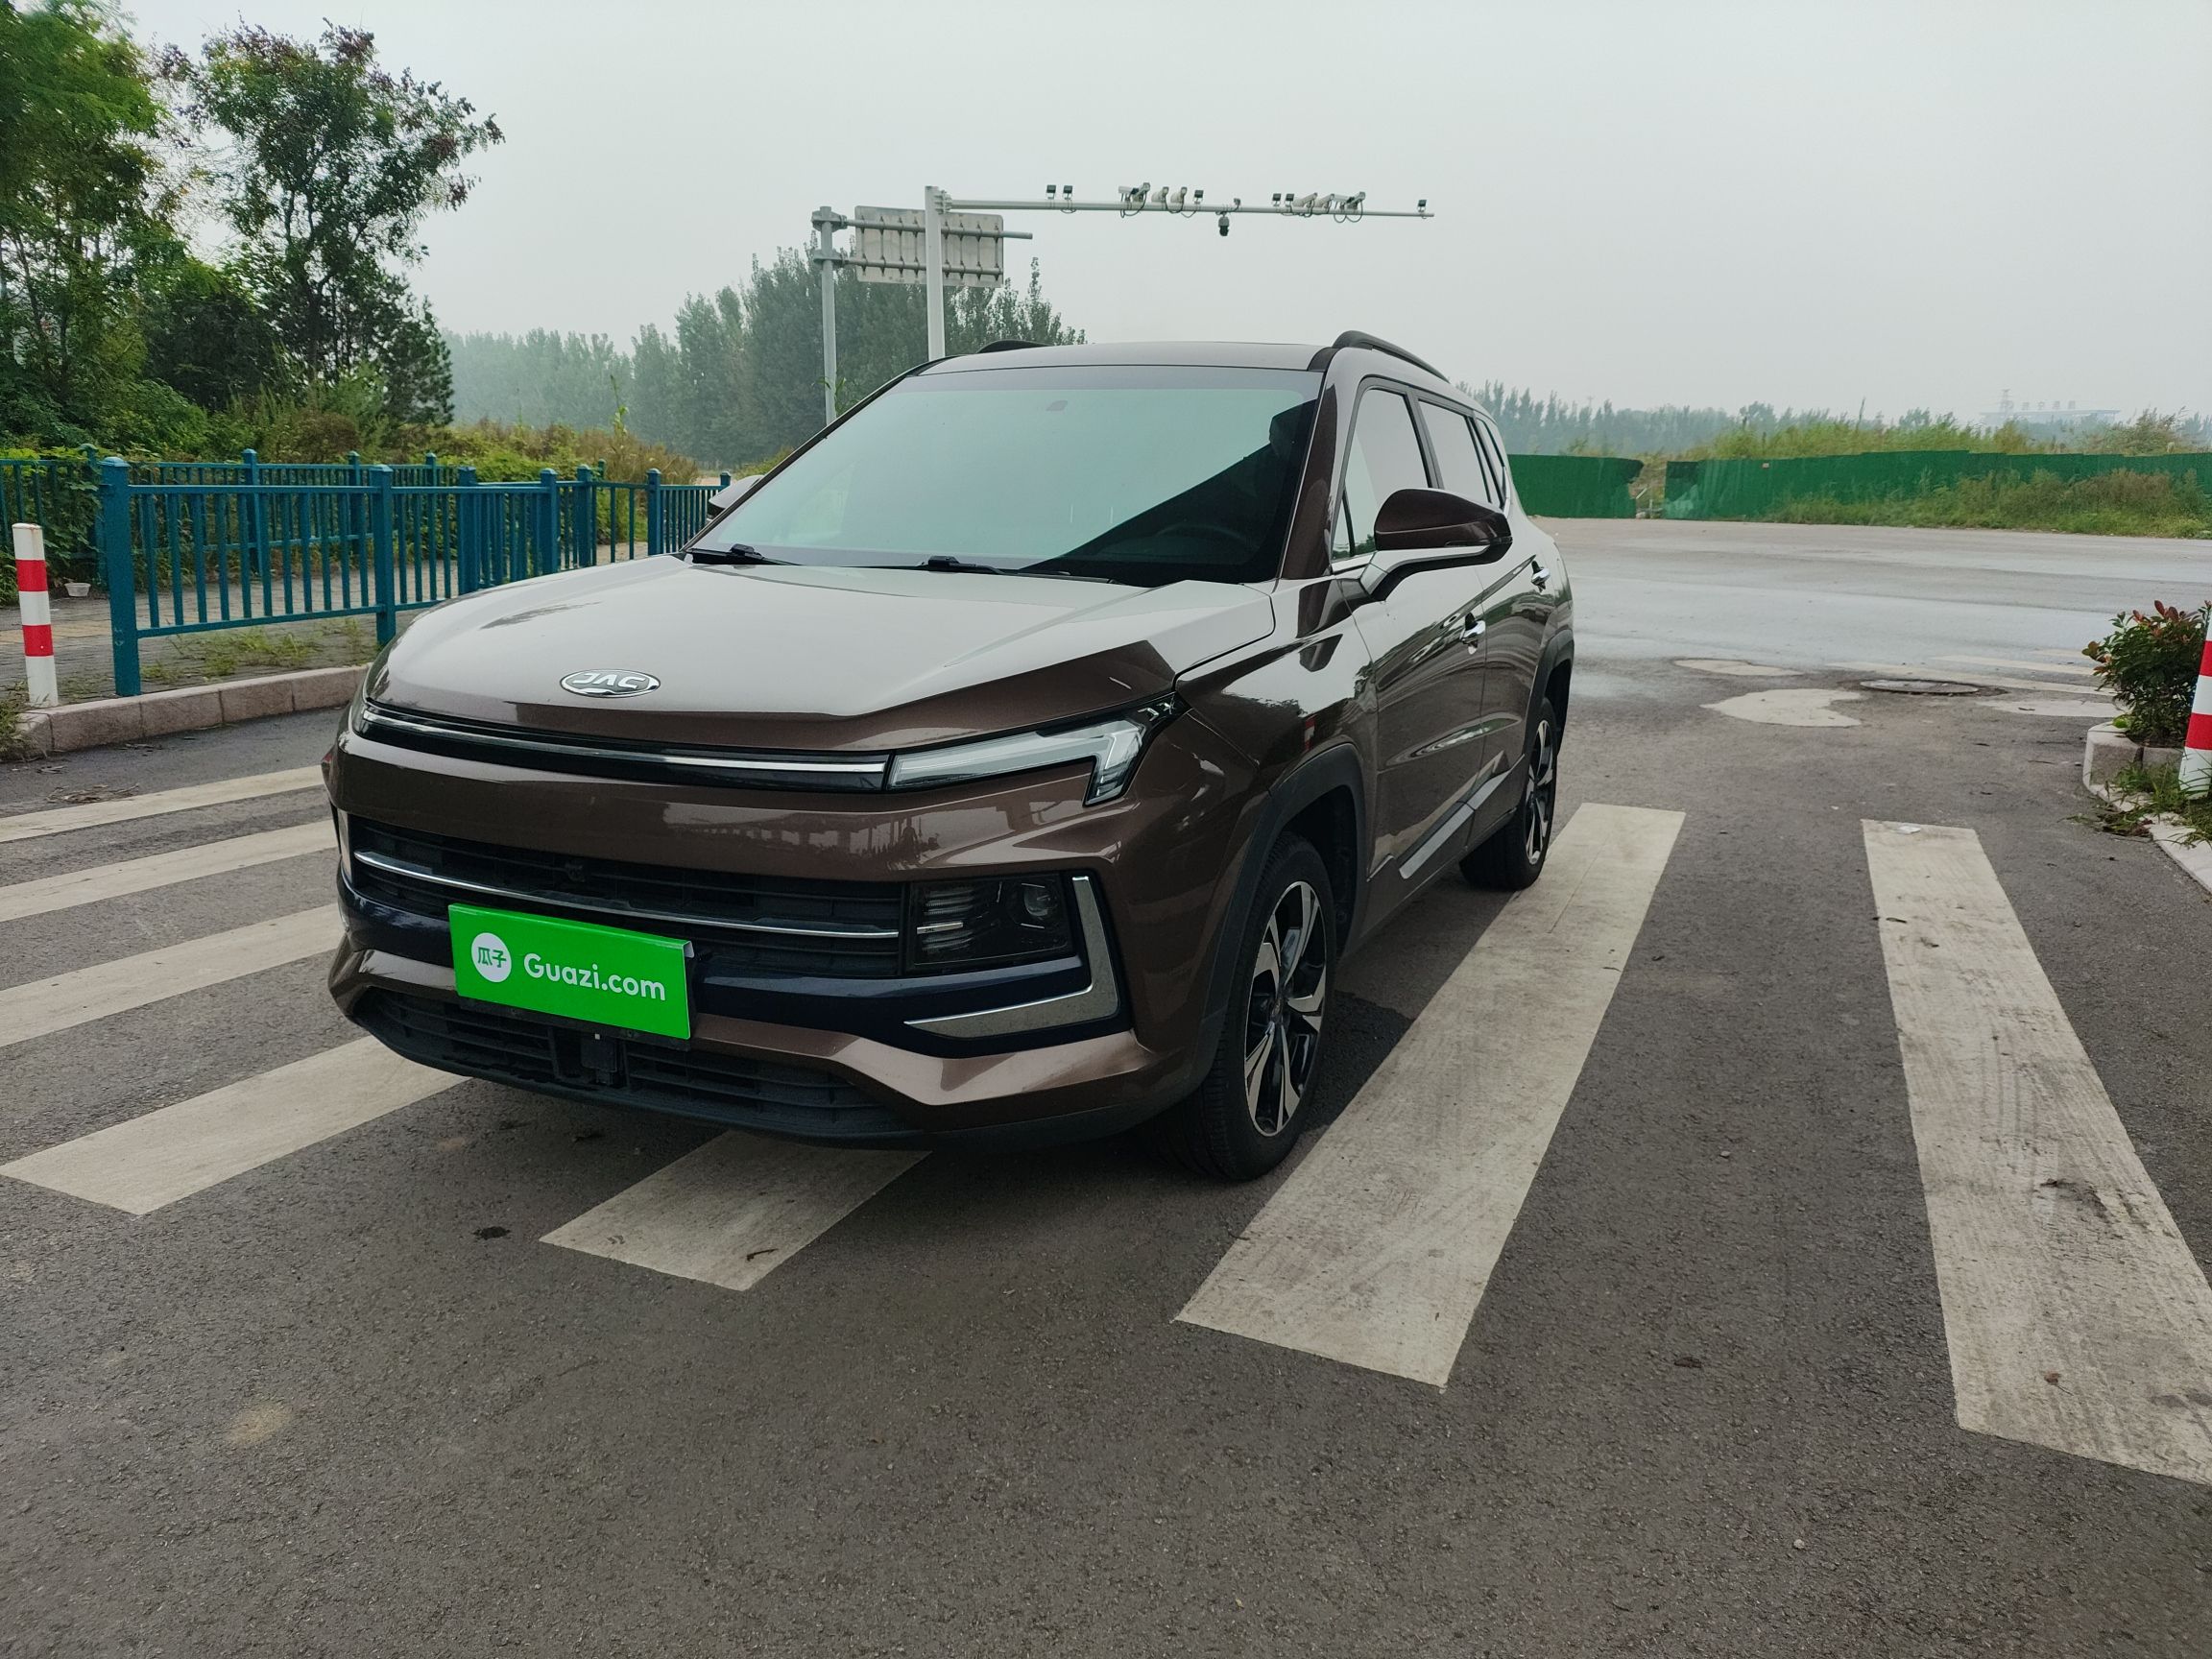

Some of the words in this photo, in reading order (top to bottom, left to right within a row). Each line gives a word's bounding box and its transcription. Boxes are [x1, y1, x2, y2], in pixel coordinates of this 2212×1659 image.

[573, 672, 645, 689] JAC
[477, 947, 507, 968] 瓜子
[523, 953, 665, 1000] Guazi.com
